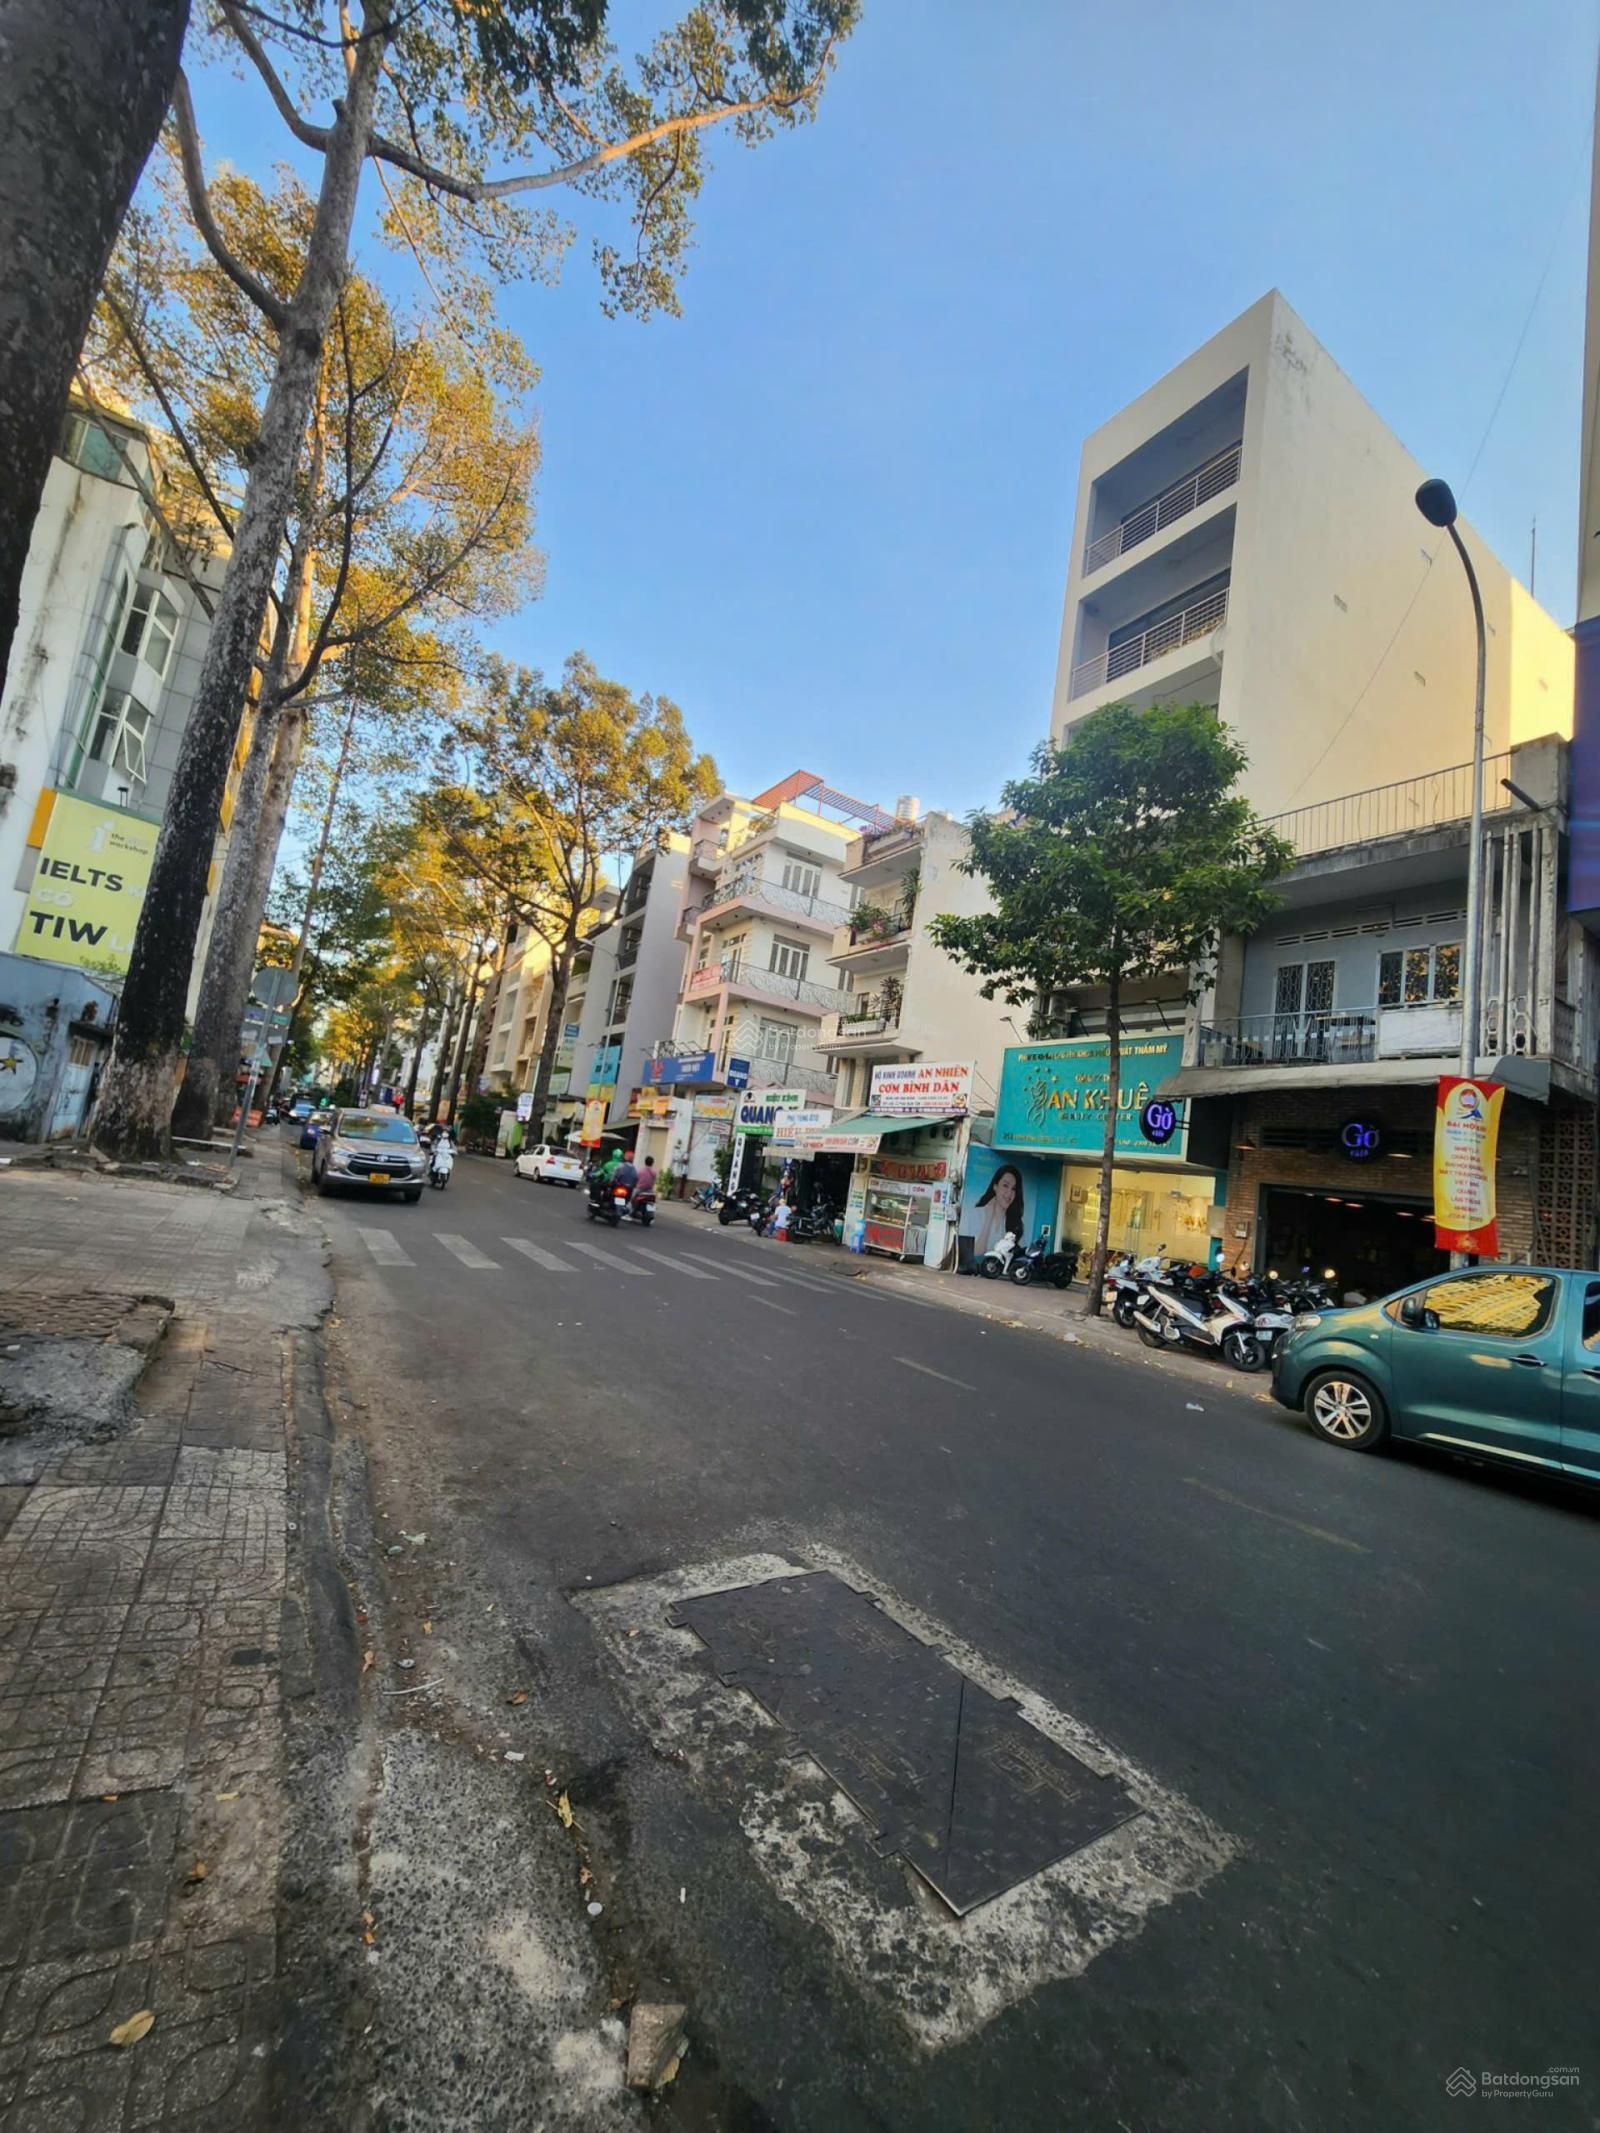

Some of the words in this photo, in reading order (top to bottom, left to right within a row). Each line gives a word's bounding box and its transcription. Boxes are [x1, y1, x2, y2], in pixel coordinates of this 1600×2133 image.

[109, 839, 149, 856] workshop
[40, 857, 124, 892] IELTS
[30, 909, 108, 946] TIW
[1155, 1044, 1168, 1054] MỸ
[918, 1067, 933, 1079] AN
[935, 1063, 969, 1078] NHIÊN
[879, 1081, 901, 1094] CƠM
[903, 1080, 930, 1093] BÌNH
[933, 1079, 960, 1093] DÂN
[1048, 1088, 1079, 1110] AN
[1147, 1104, 1173, 1130] Gờ
[1342, 1123, 1380, 1149] Gờ
